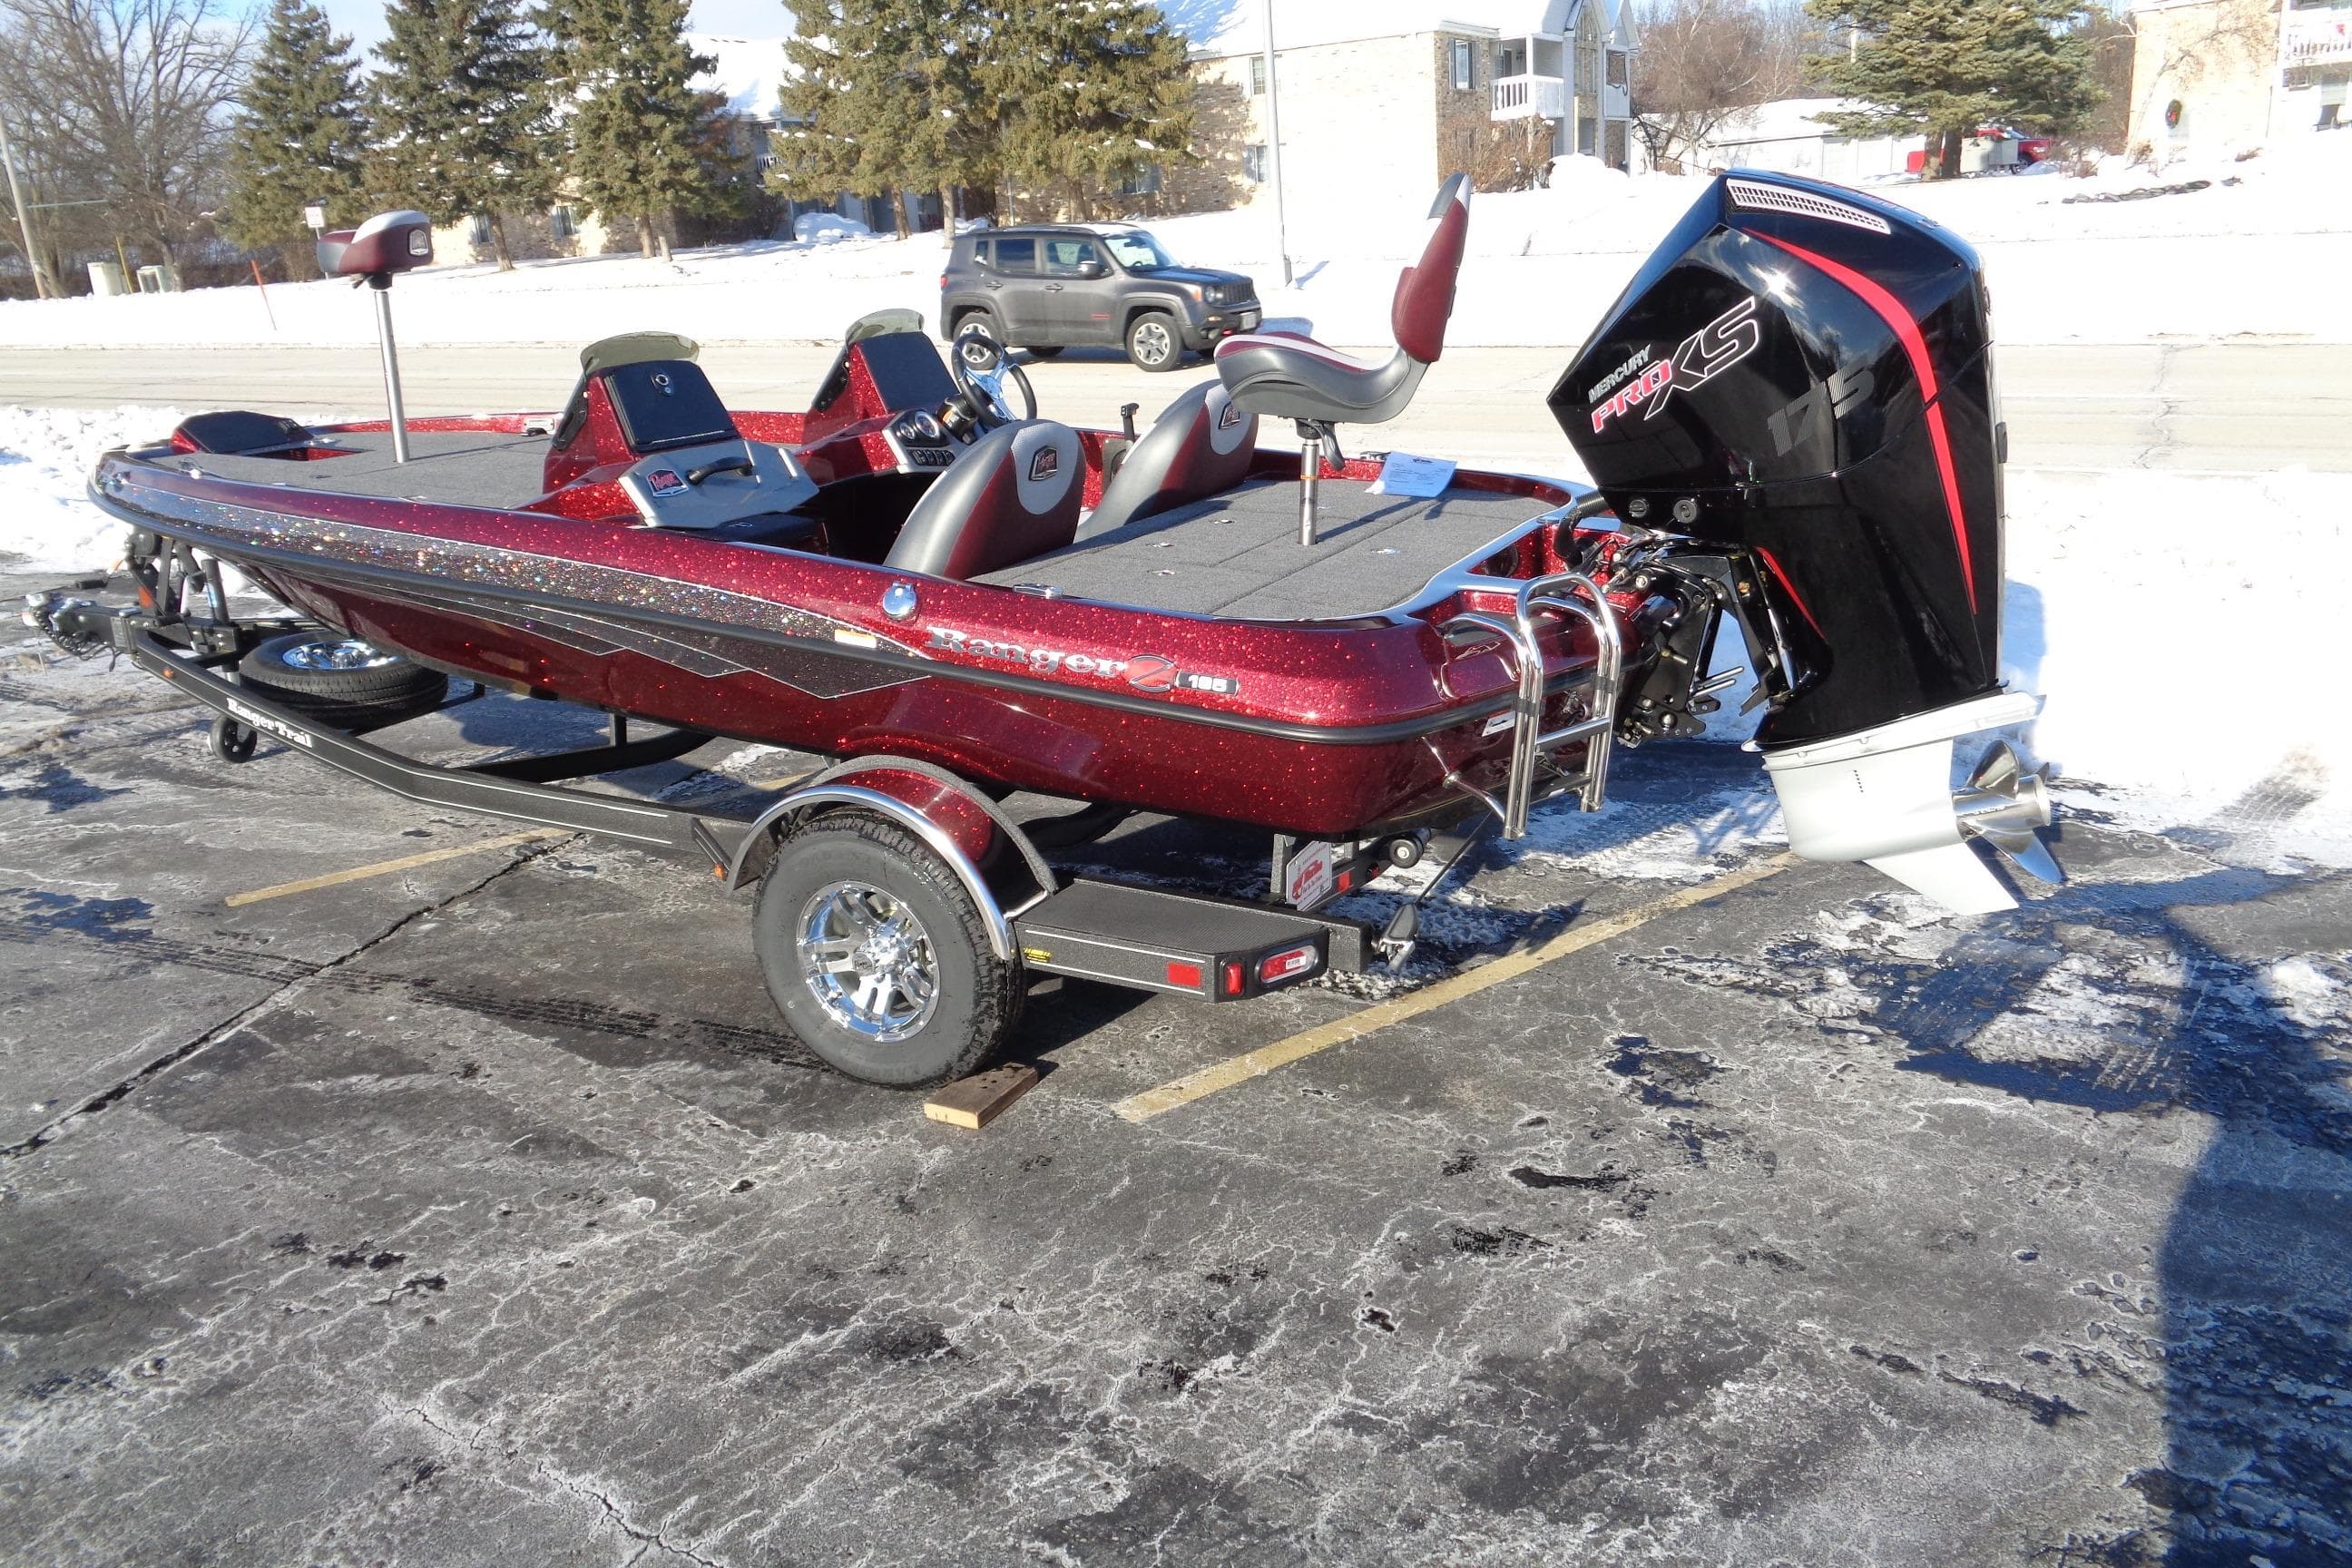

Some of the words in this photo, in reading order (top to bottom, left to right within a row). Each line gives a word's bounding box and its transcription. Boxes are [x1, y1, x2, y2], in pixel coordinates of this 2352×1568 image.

[1588, 344, 1651, 404] MERCURY
[1767, 364, 1876, 457] 175
[925, 625, 1128, 678] Ranger
[226, 697, 274, 730] Ranger
[274, 720, 313, 749] Trail
